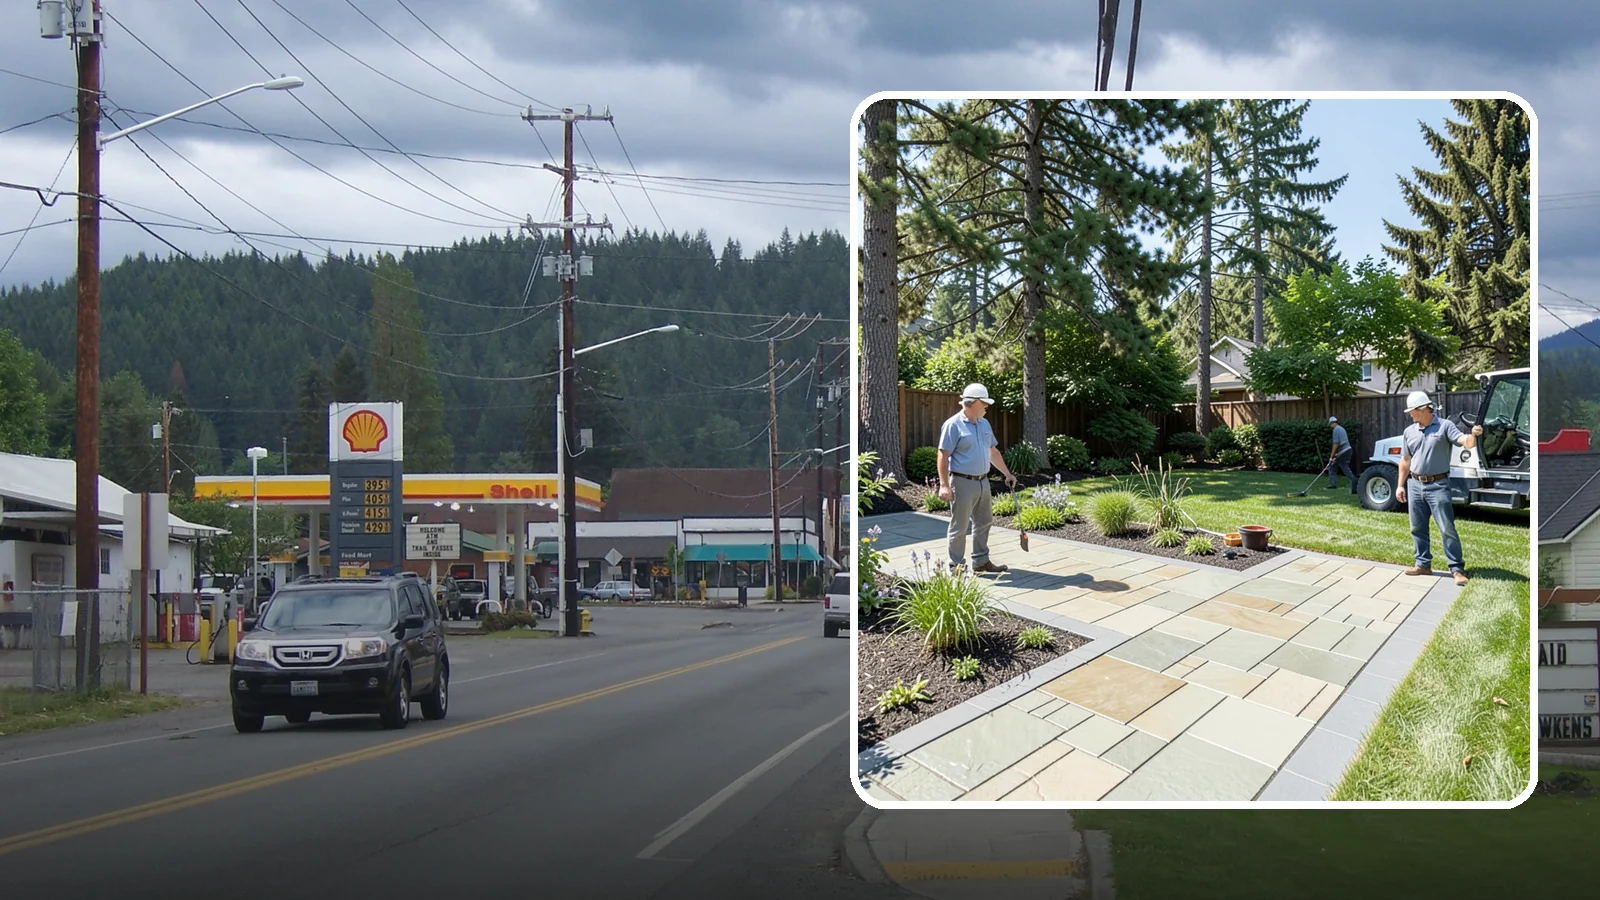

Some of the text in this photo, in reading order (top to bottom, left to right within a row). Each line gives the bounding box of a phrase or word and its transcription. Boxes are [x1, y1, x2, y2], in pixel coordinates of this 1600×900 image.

[365, 480, 384, 490] 395
[490, 484, 547, 499] Shell
[365, 494, 384, 504] 405
[365, 508, 384, 518] 415
[365, 522, 384, 532] 429
